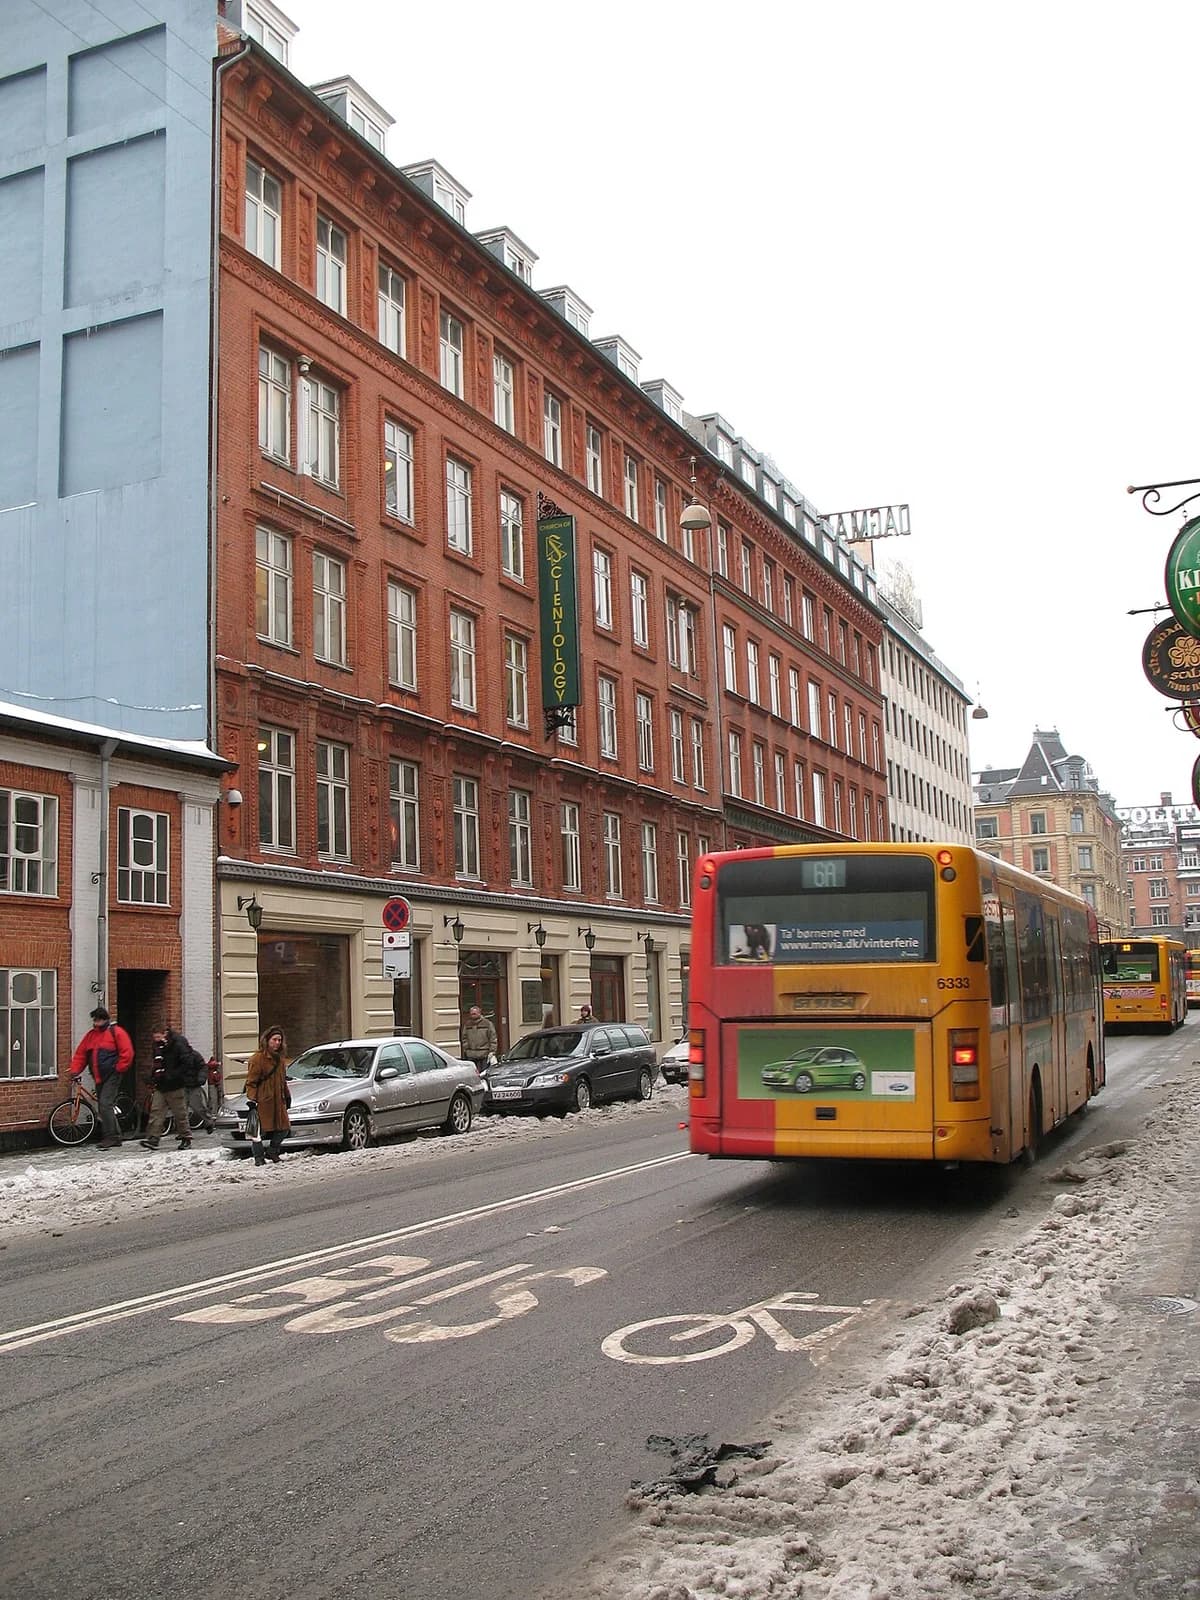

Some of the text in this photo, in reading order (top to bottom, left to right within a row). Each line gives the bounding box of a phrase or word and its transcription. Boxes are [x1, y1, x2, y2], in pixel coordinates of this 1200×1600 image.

[539, 523, 562, 531] CHURCH
[547, 534, 567, 702] SCIENTOLOGY
[814, 862, 837, 887] 6A
[797, 928, 840, 938] børnene
[842, 927, 866, 937] med
[780, 937, 919, 950] www.movia.dk/vinterferie
[937, 977, 969, 989] 6333
[170, 1255, 608, 1344] BUS
